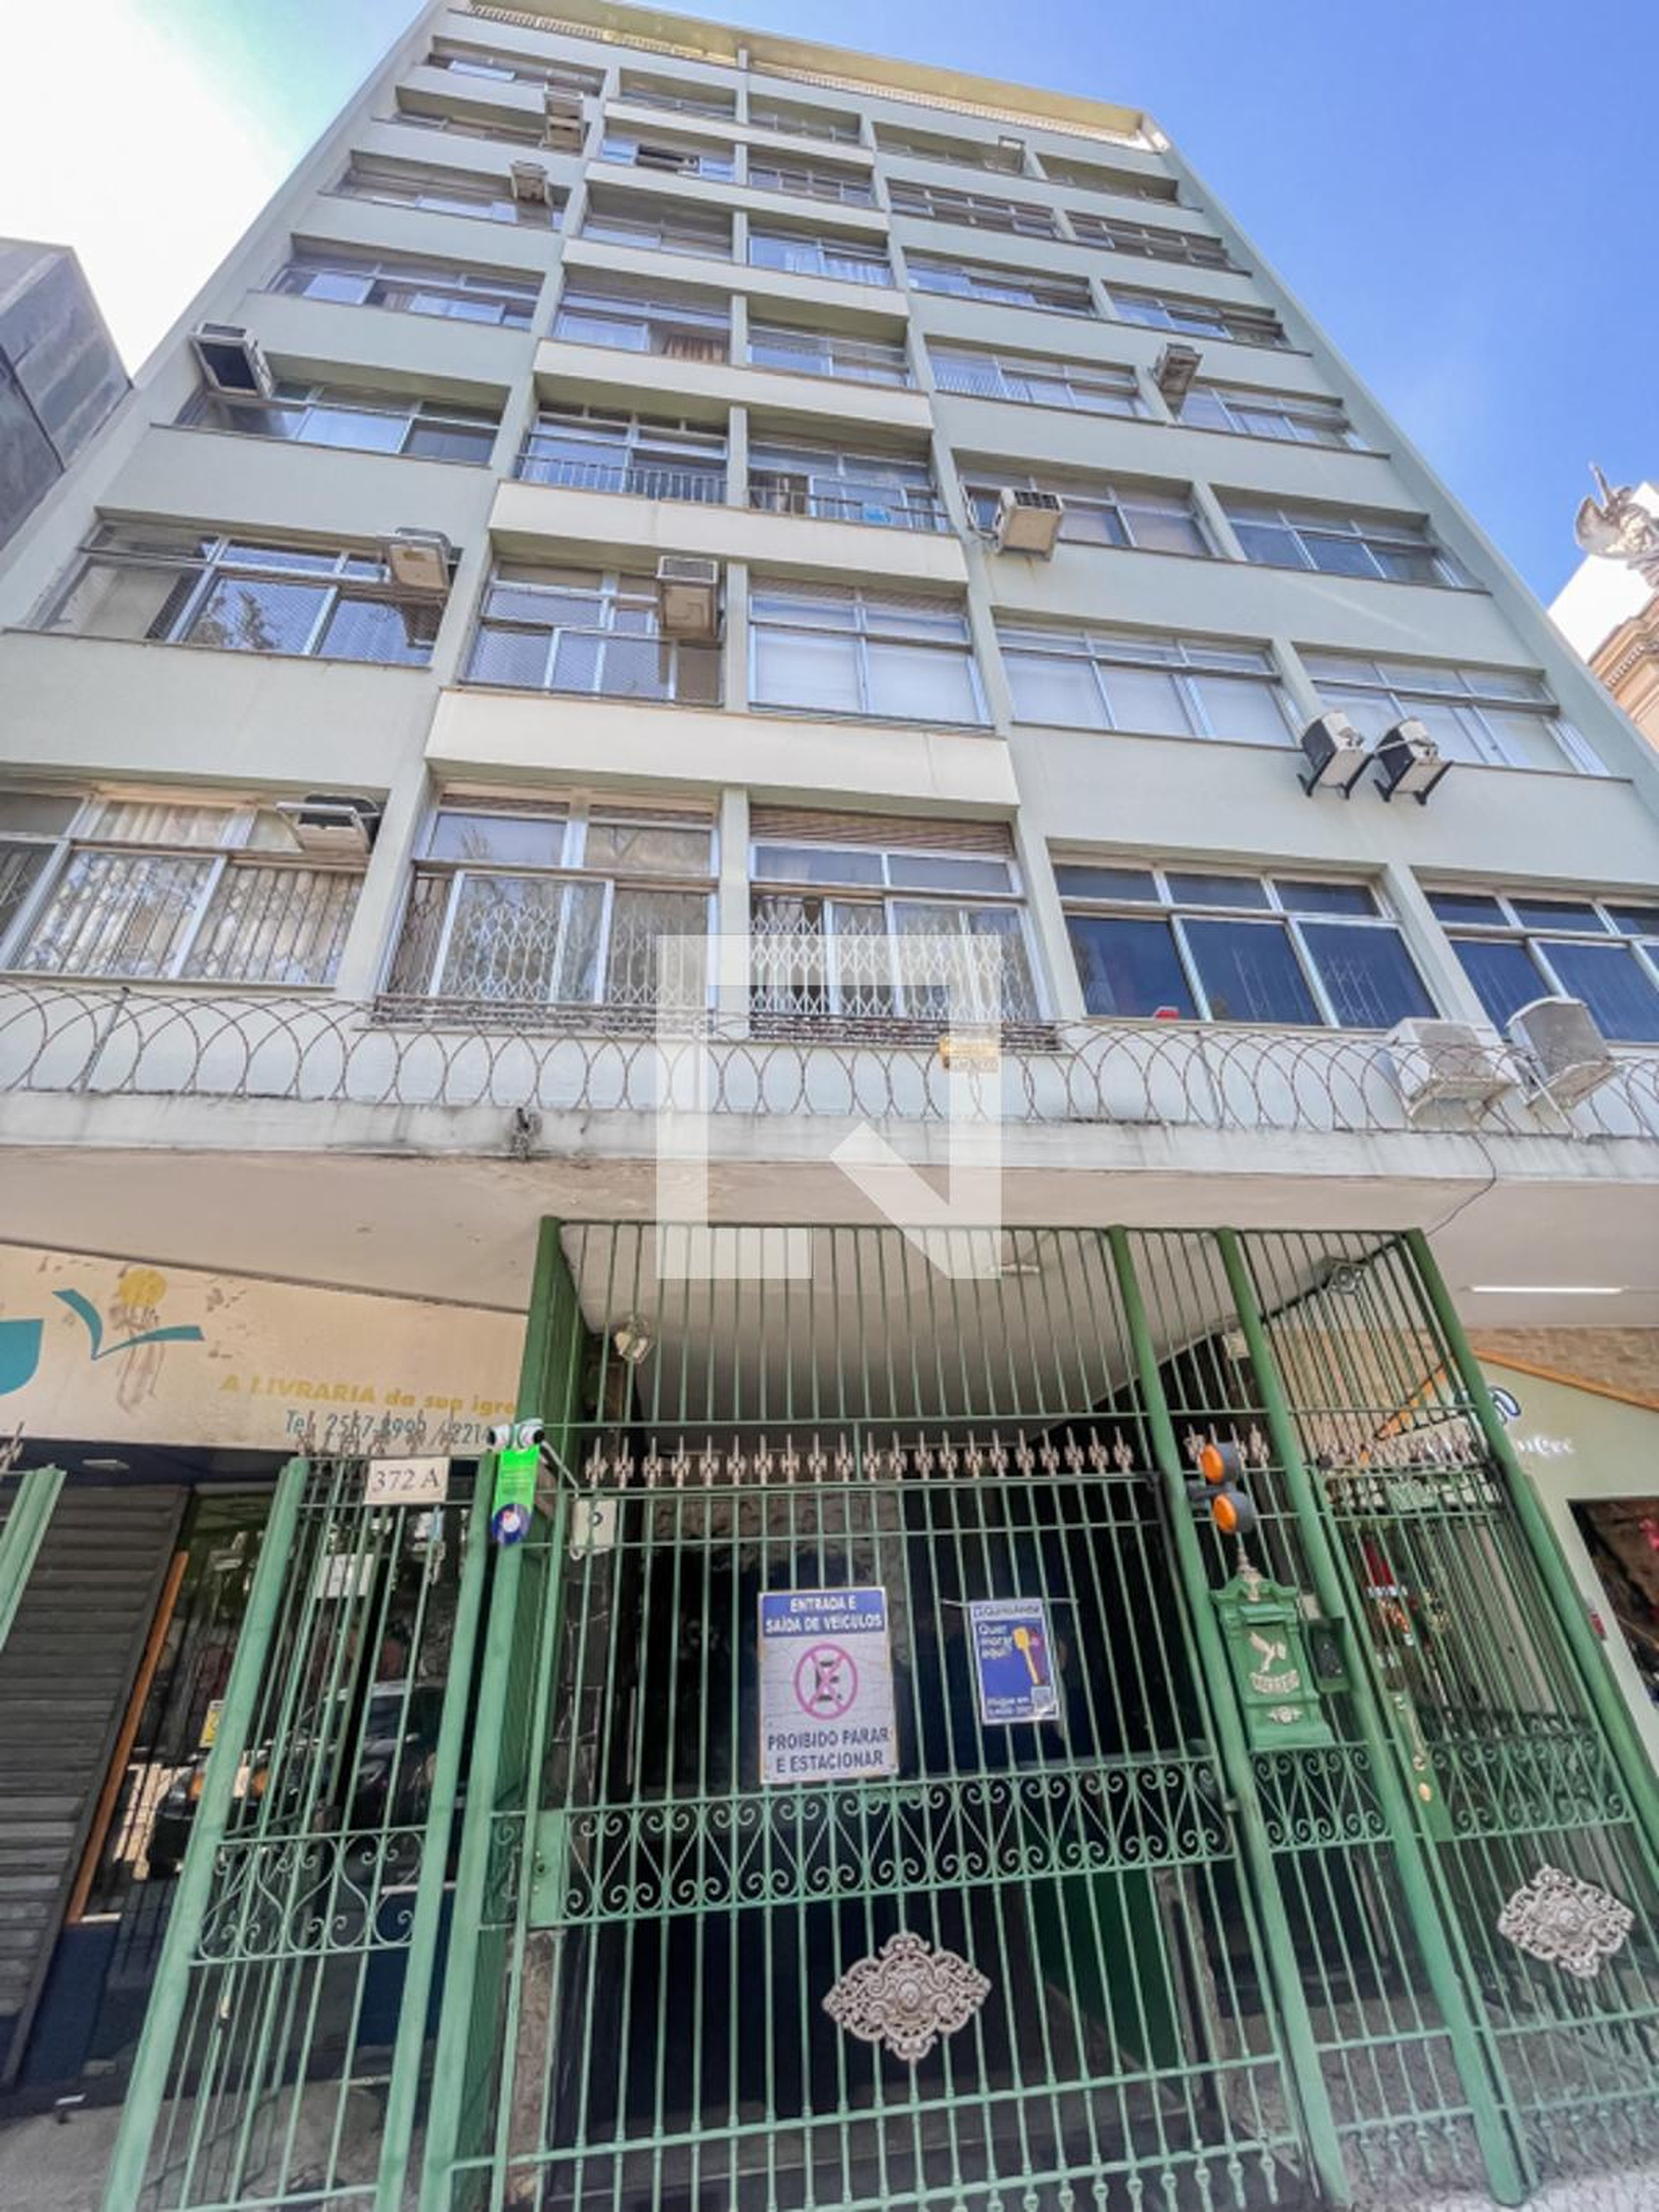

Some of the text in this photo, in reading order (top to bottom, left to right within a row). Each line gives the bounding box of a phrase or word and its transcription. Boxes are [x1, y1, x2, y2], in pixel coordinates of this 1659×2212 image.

[372, 1467, 440, 1493] 372 A
[790, 1595, 857, 1613] ENTRADA E
[804, 1617, 820, 1633] DE
[768, 1727, 889, 1751] PROIBIDO PARAR
[776, 1750, 884, 1773] E ESTACIONAR
